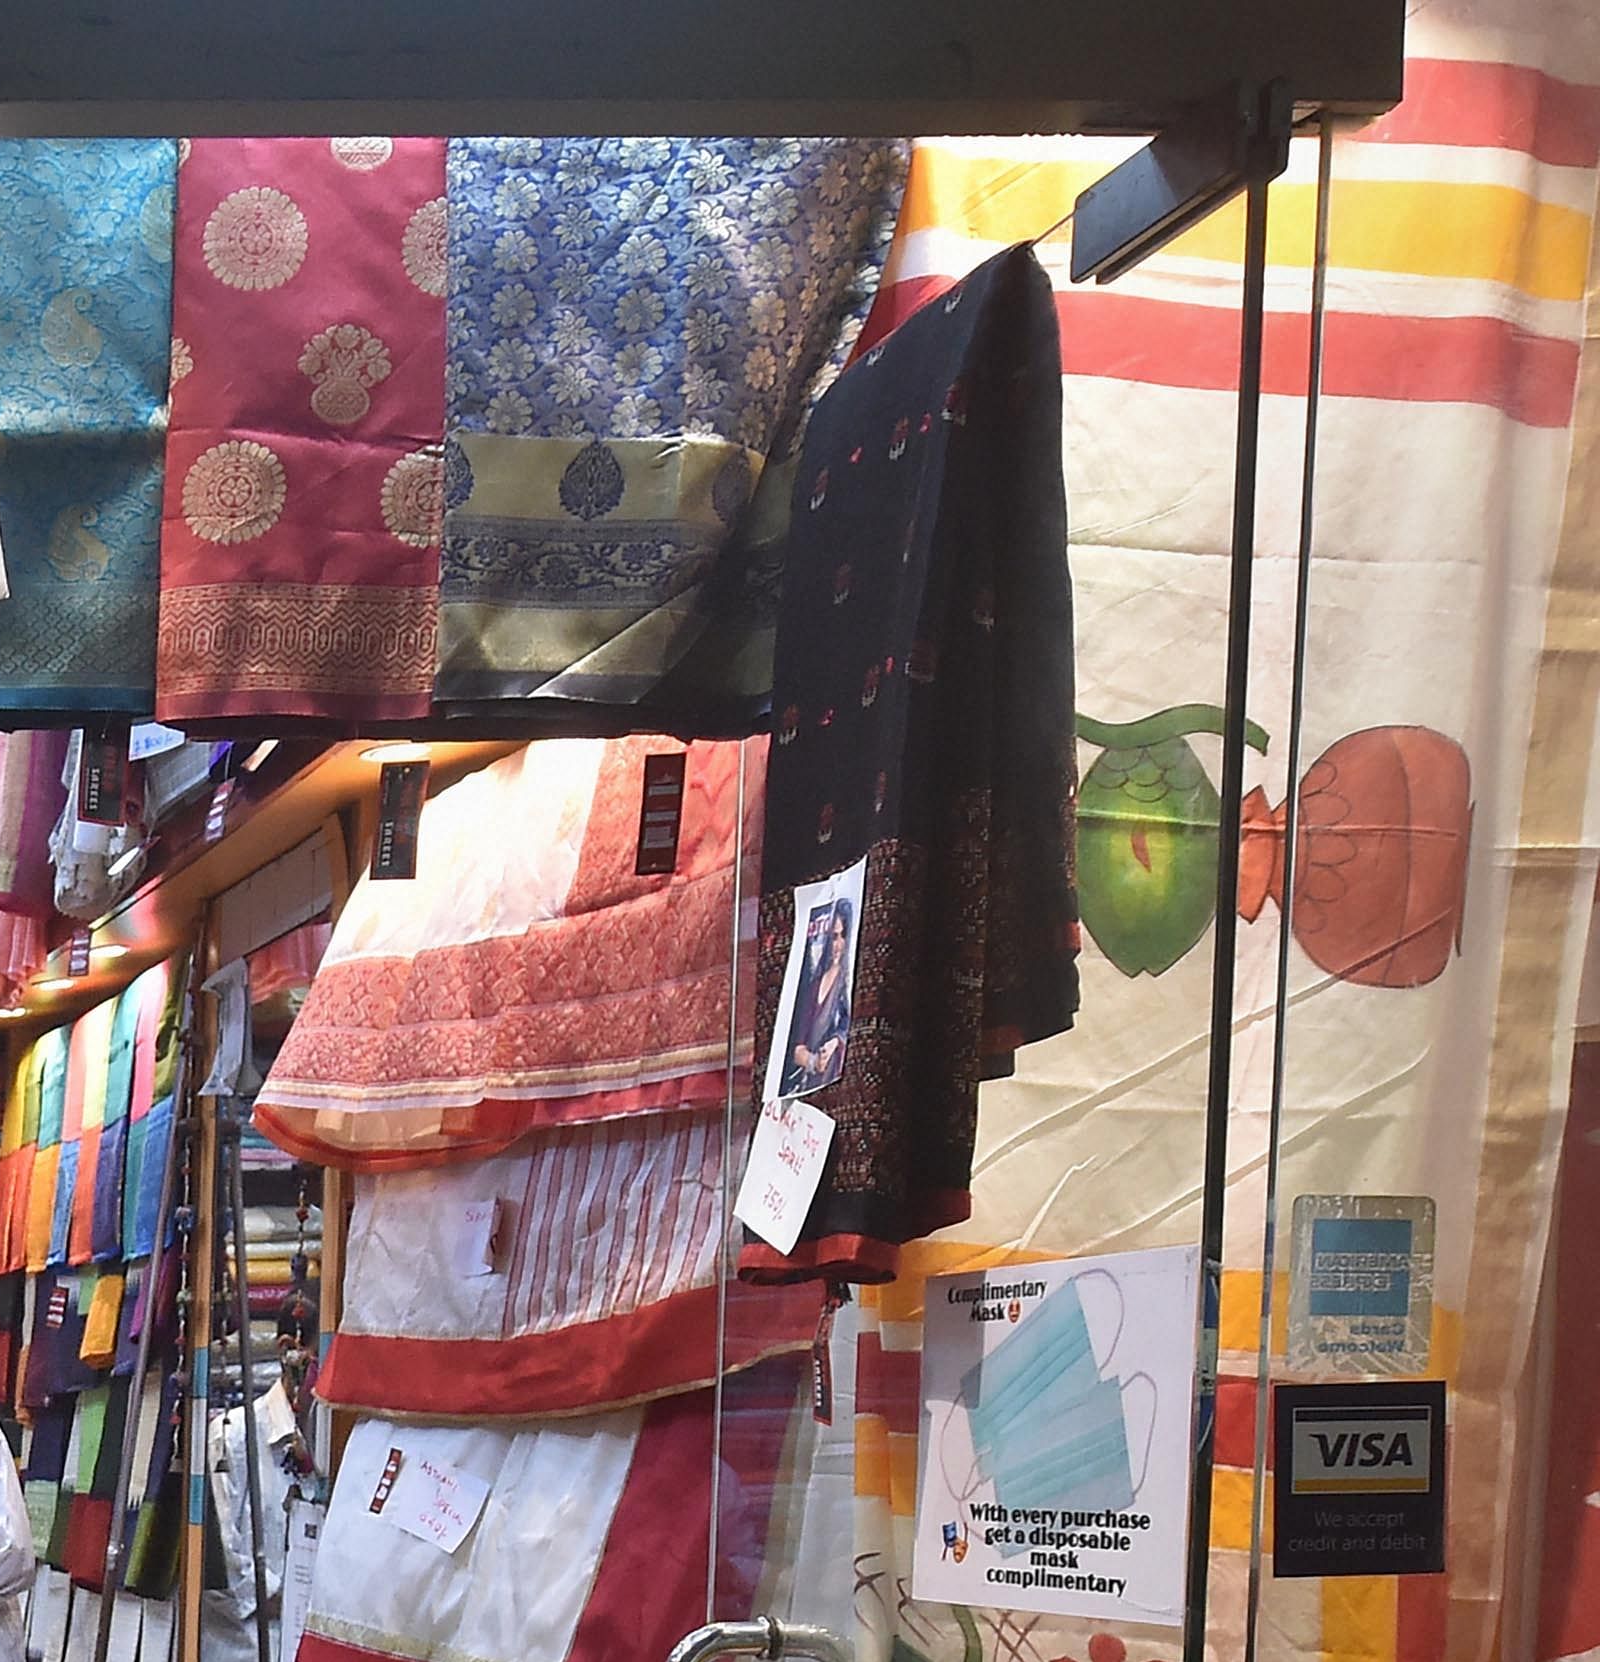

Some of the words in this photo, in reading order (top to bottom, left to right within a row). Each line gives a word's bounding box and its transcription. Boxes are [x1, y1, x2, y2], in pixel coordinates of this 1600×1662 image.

[947, 1279, 1049, 1304] Complimentary
[969, 1302, 1006, 1322] Mask
[1309, 1432, 1413, 1468] VISA
[969, 1503, 1009, 1523] With
[1012, 1508, 1058, 1529] every
[1060, 1509, 1151, 1531] purchase
[1314, 1512, 1342, 1528] We
[1346, 1512, 1404, 1529] accept
[984, 1528, 1013, 1545] get
[1015, 1531, 1025, 1544] a
[1029, 1530, 1131, 1552] disposable
[1342, 1535, 1376, 1550] and
[1029, 1551, 1080, 1570] mask
[985, 1568, 1127, 1597] complimentary
